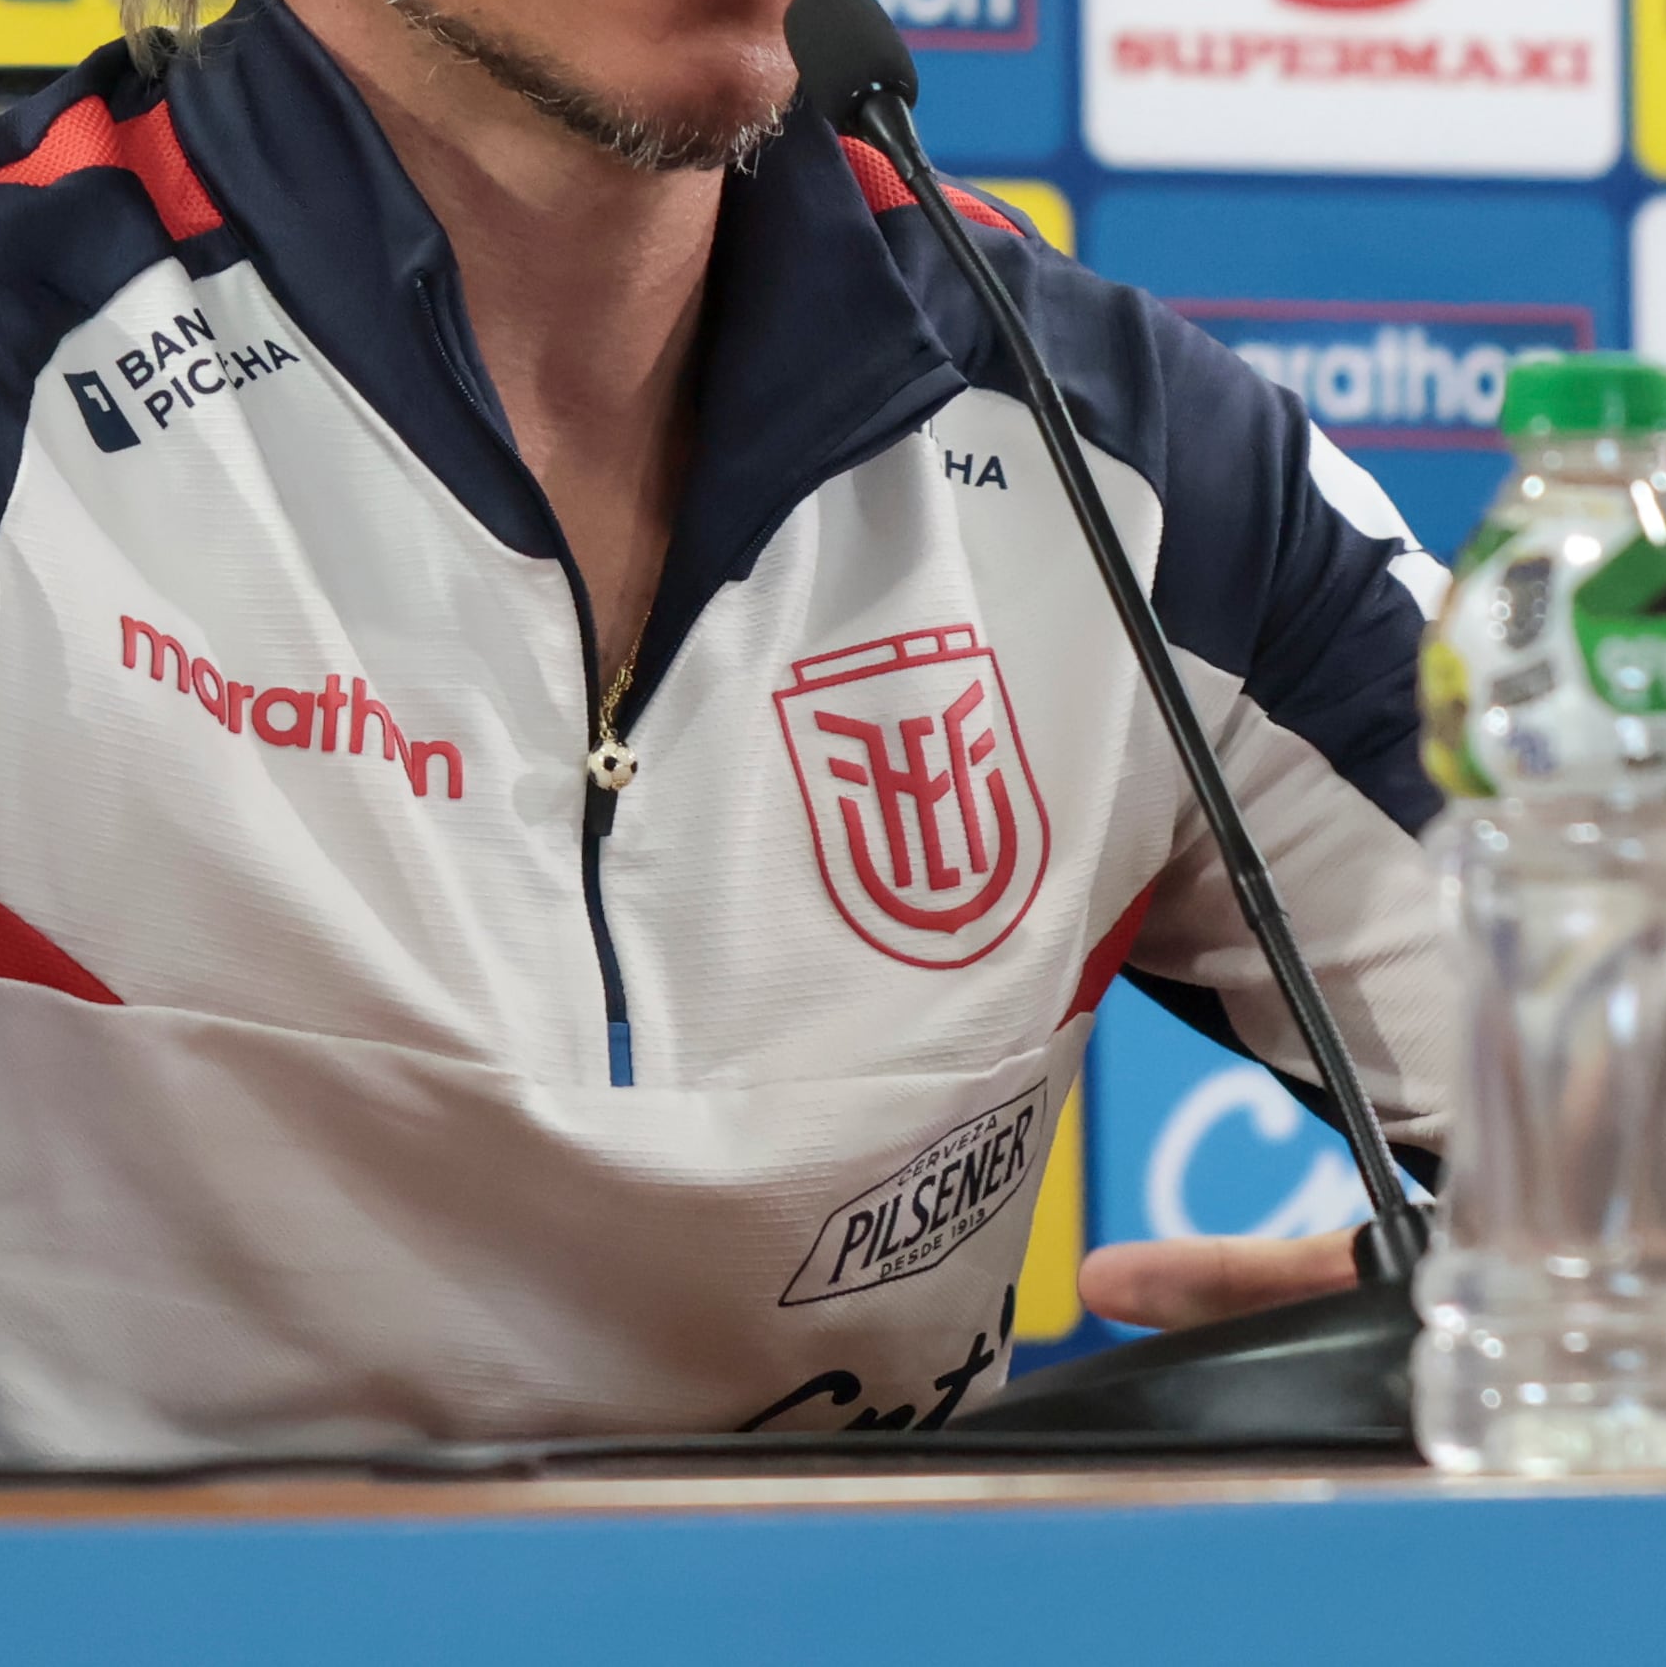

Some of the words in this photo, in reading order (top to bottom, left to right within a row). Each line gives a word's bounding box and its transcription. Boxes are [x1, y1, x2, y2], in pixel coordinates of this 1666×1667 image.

[1112, 32, 1591, 86] SUPERMAXI
[897, 1114, 998, 1187] CERVEZA
[827, 1105, 1033, 1285] PILSENER
[879, 1235, 943, 1279] DESDE
[951, 1208, 986, 1240] 1913
